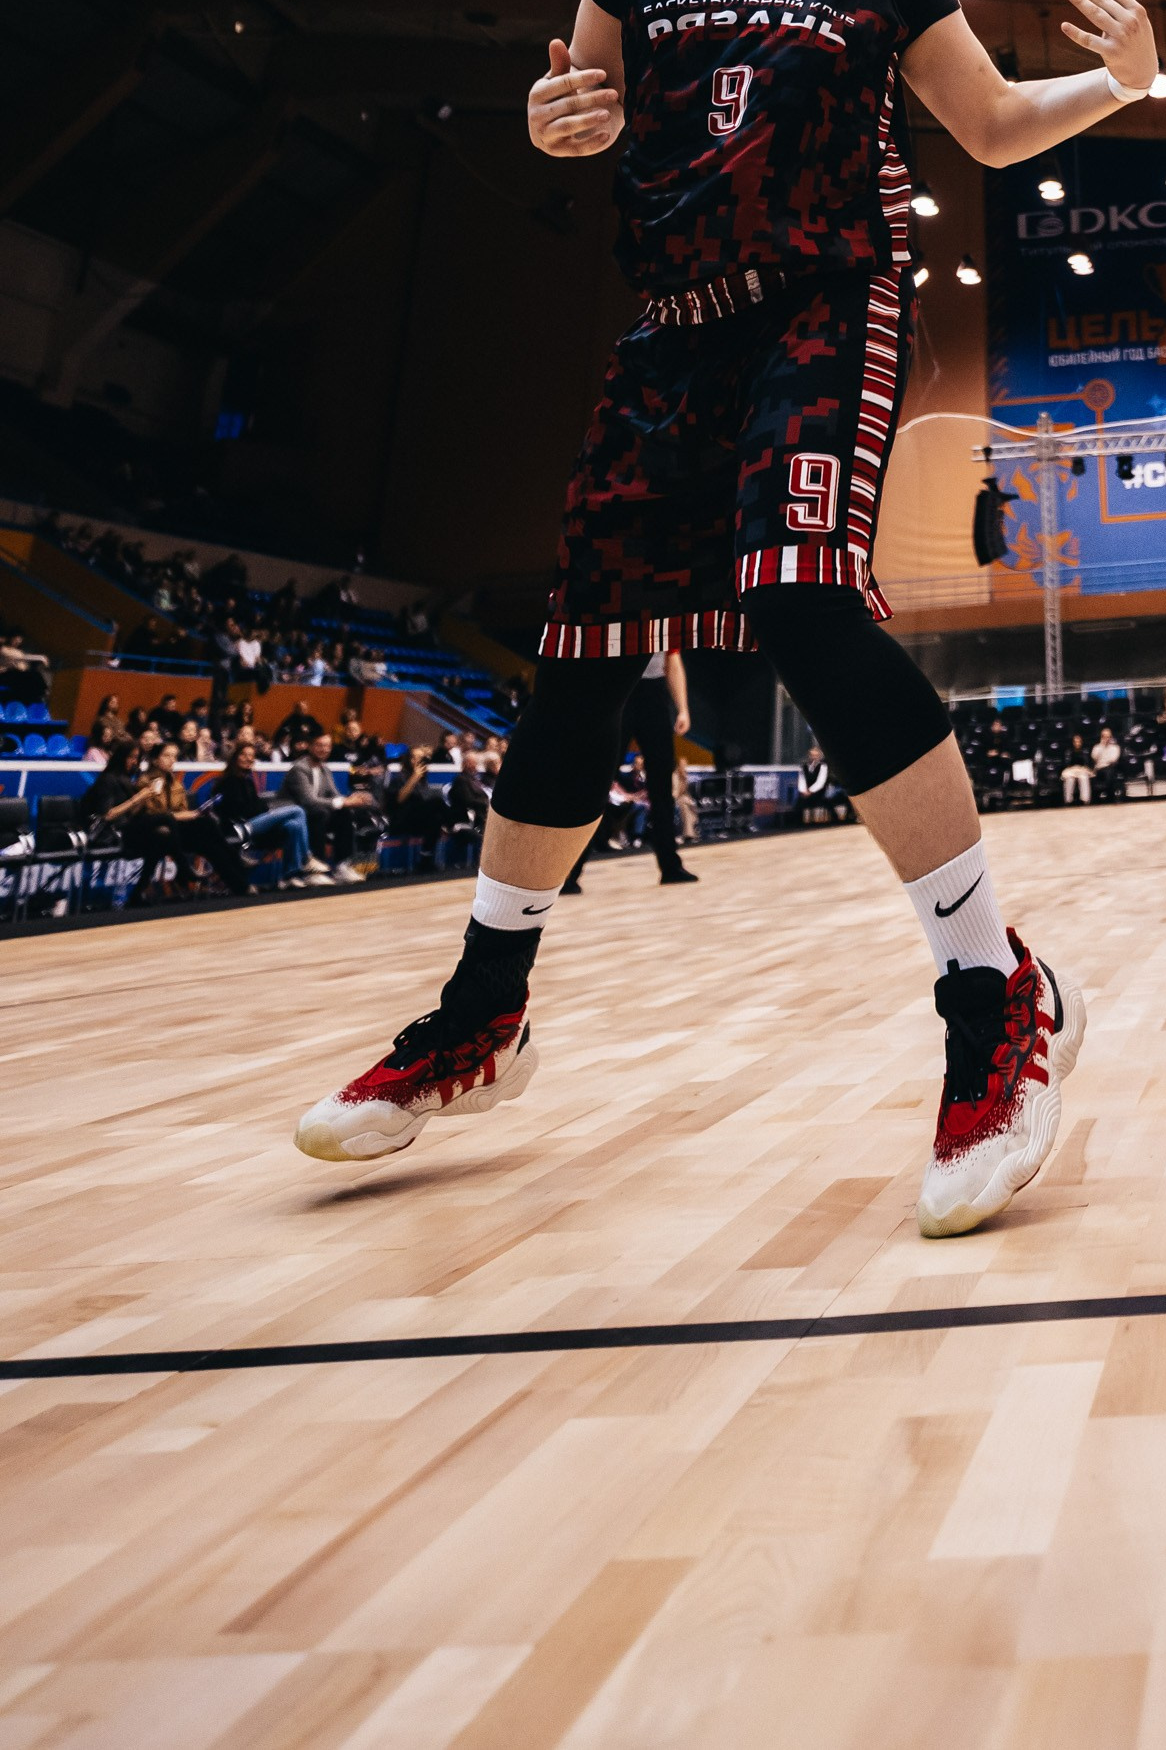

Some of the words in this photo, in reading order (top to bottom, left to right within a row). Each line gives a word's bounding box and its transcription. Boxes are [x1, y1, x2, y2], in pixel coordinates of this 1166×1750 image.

[647, 9, 848, 54] РЯЗАНЬ
[707, 64, 754, 136] 9
[1047, 347, 1121, 367] ЮБИЛЕЙНЫЙ
[1123, 346, 1146, 363] ГОД
[786, 452, 842, 533] 9
